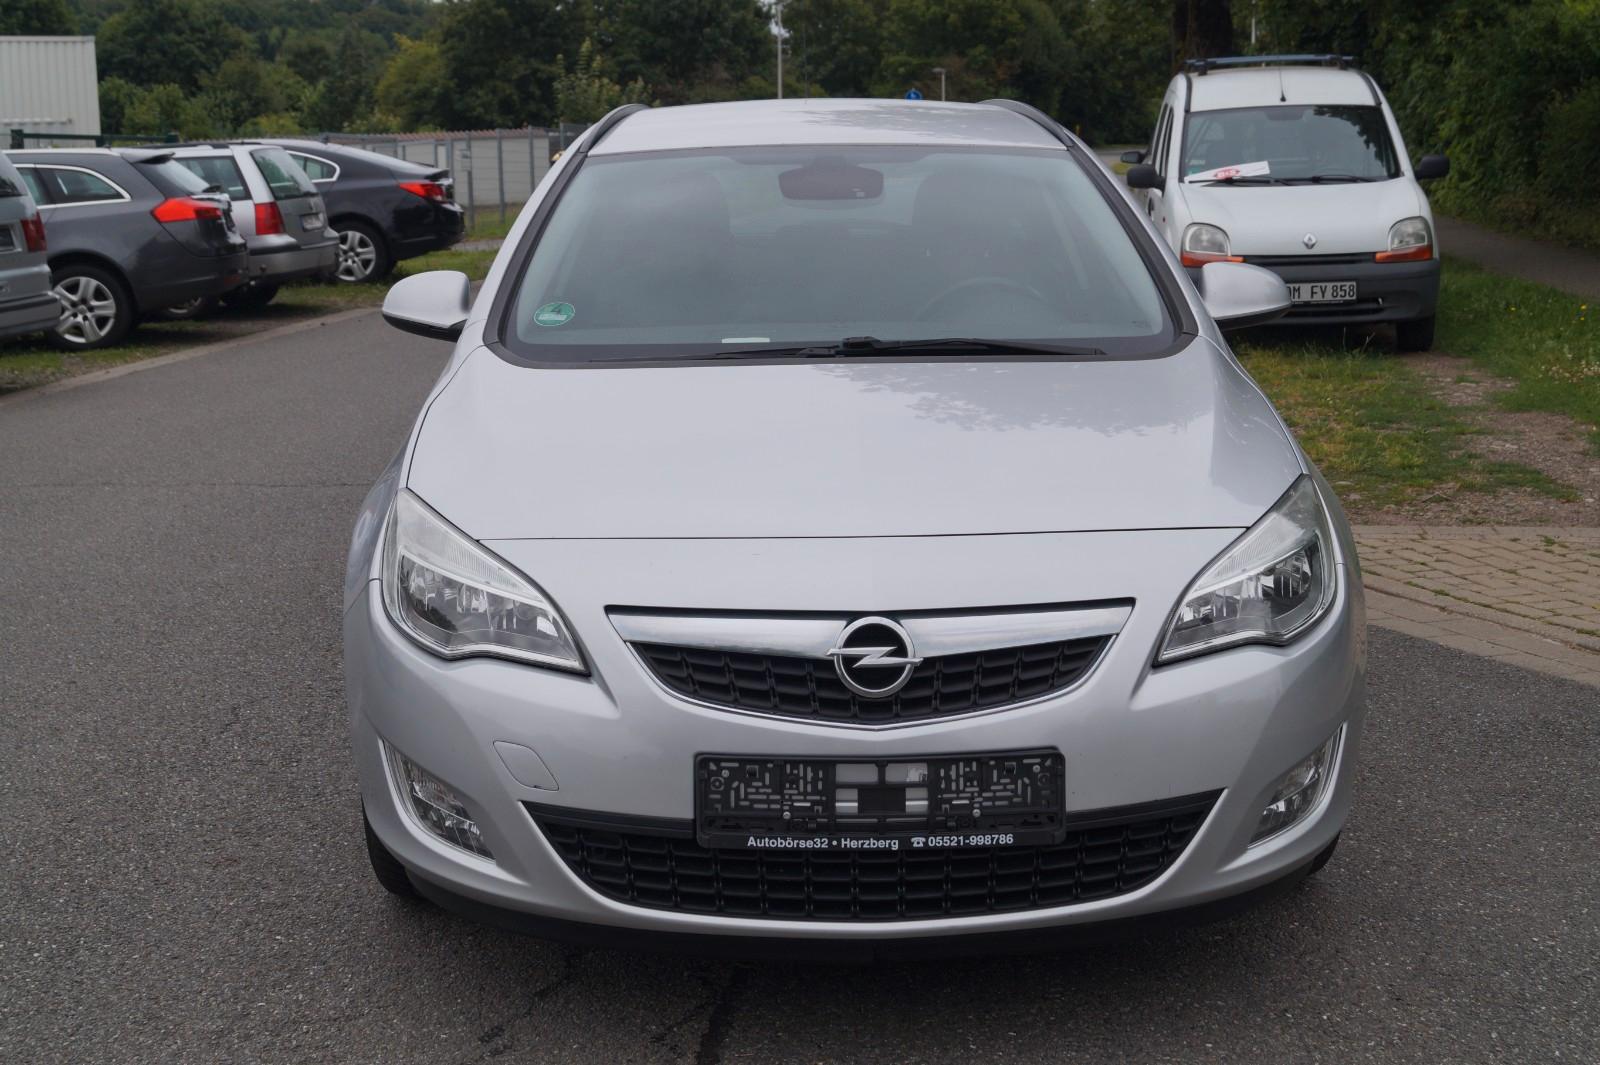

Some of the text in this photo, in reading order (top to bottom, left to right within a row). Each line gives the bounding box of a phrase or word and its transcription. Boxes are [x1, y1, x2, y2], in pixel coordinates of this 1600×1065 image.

[1310, 285, 1328, 299] FY
[1331, 284, 1355, 298] 858
[550, 303, 562, 315] 4
[747, 834, 1014, 850] Autobörse32 Herzberg 05521-998786
